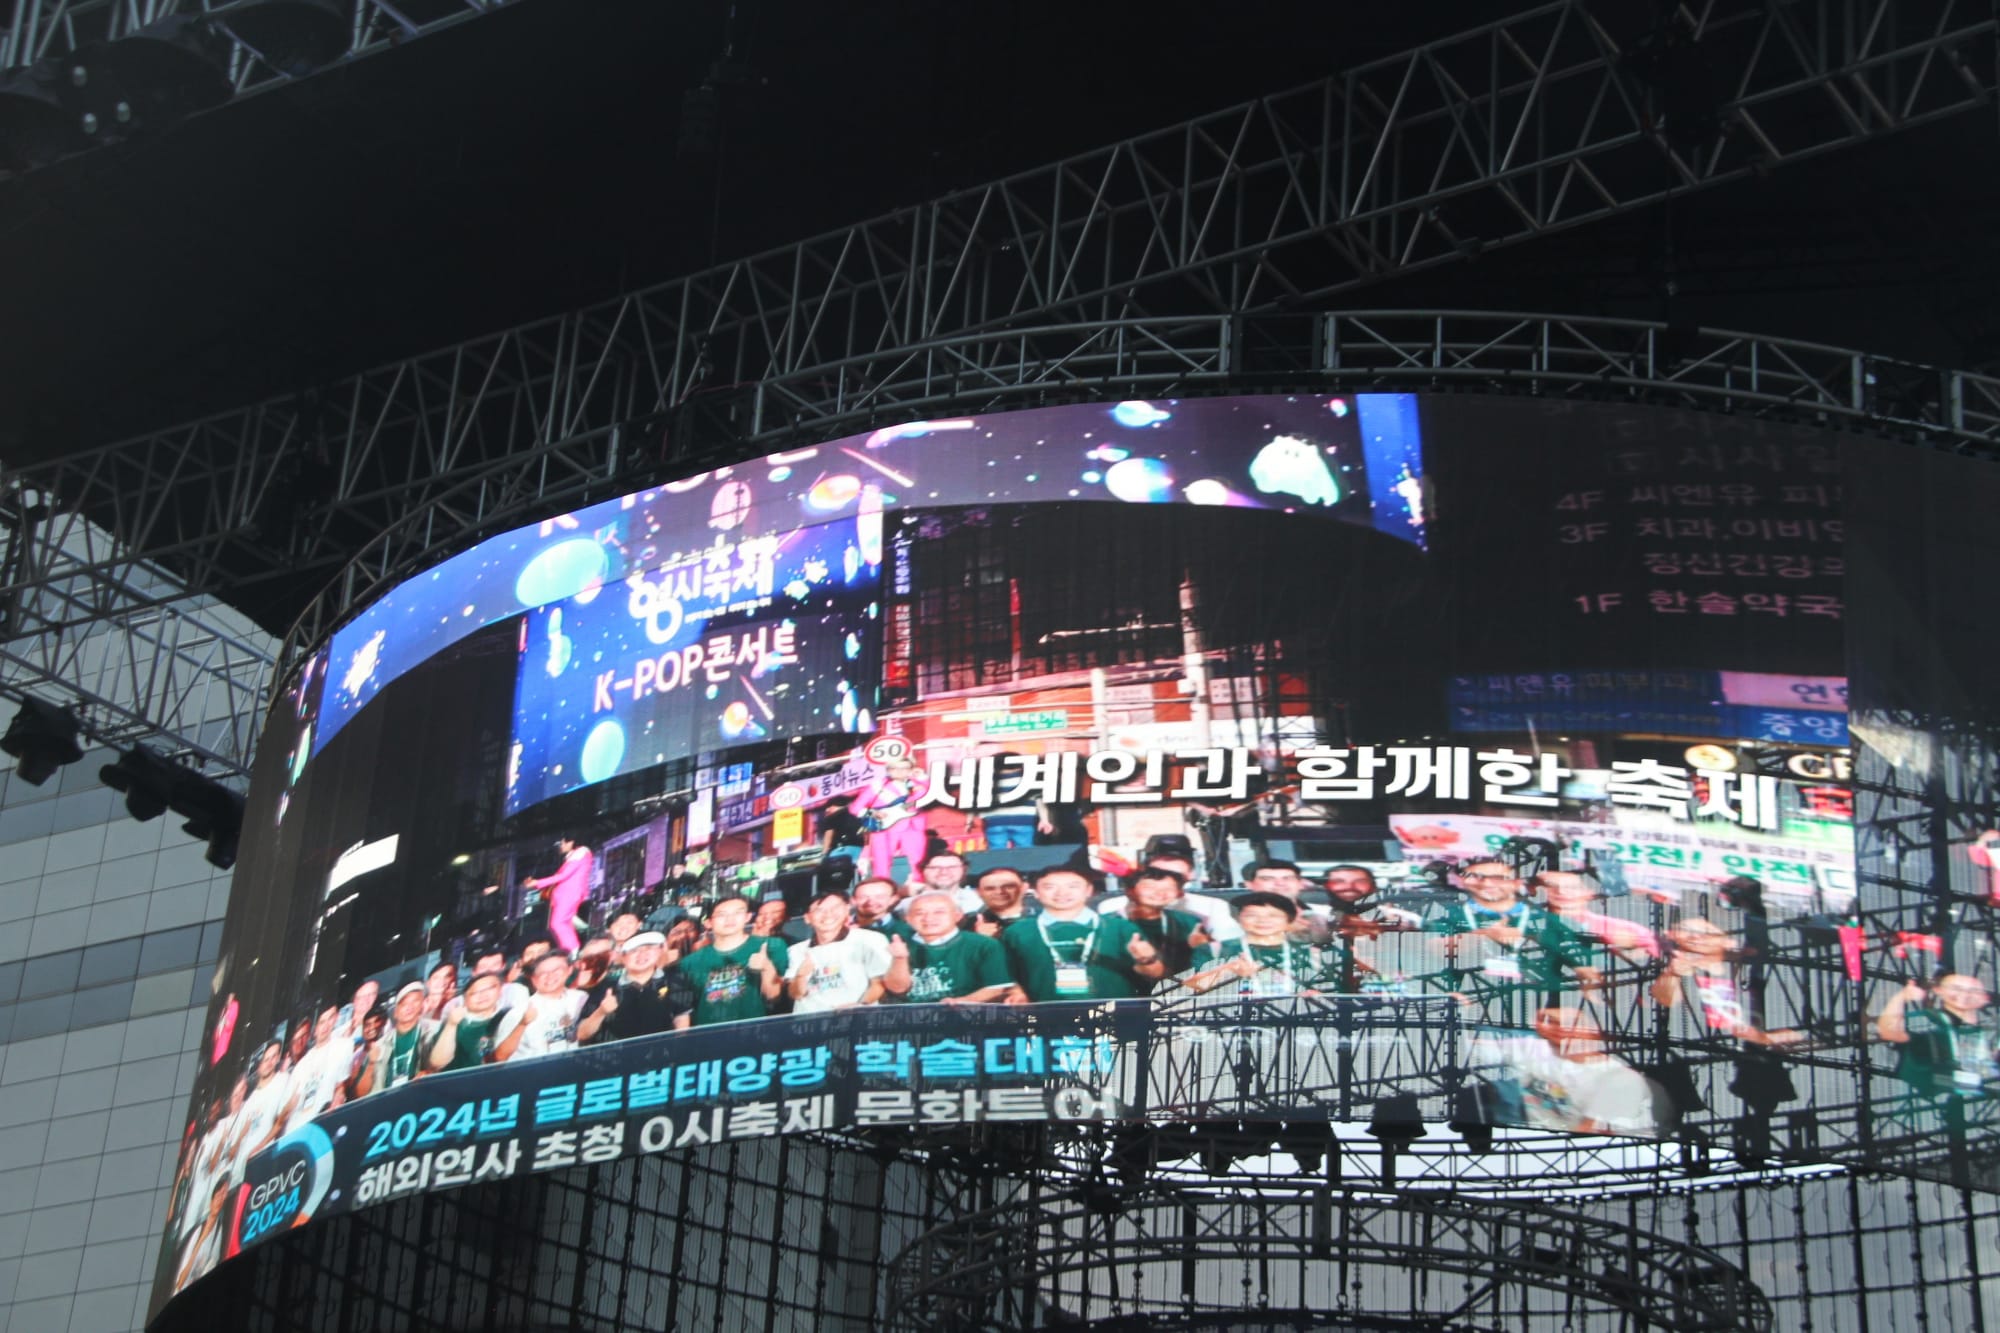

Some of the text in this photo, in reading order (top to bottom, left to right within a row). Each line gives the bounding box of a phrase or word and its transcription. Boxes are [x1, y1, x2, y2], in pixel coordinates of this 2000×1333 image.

[1555, 489, 1604, 511] 4F
[1780, 484, 1843, 508] 피
[1559, 521, 1609, 544] 3F
[1574, 590, 1845, 619] 1F 한솔약국
[593, 626, 798, 713] K-POP콘서트
[873, 743, 902, 759] 50
[915, 747, 1261, 809] 세계인과
[1295, 744, 1572, 807] 함께한
[1606, 758, 1777, 830] 축제
[366, 1093, 520, 1157] 2024년
[855, 1035, 1113, 1078] 학술대회
[357, 1139, 521, 1203] 해외연사
[532, 1120, 625, 1170] 초청
[640, 1094, 835, 1154] 0시축제
[251, 1160, 307, 1209] GPVC
[242, 1186, 300, 1243] 2024
